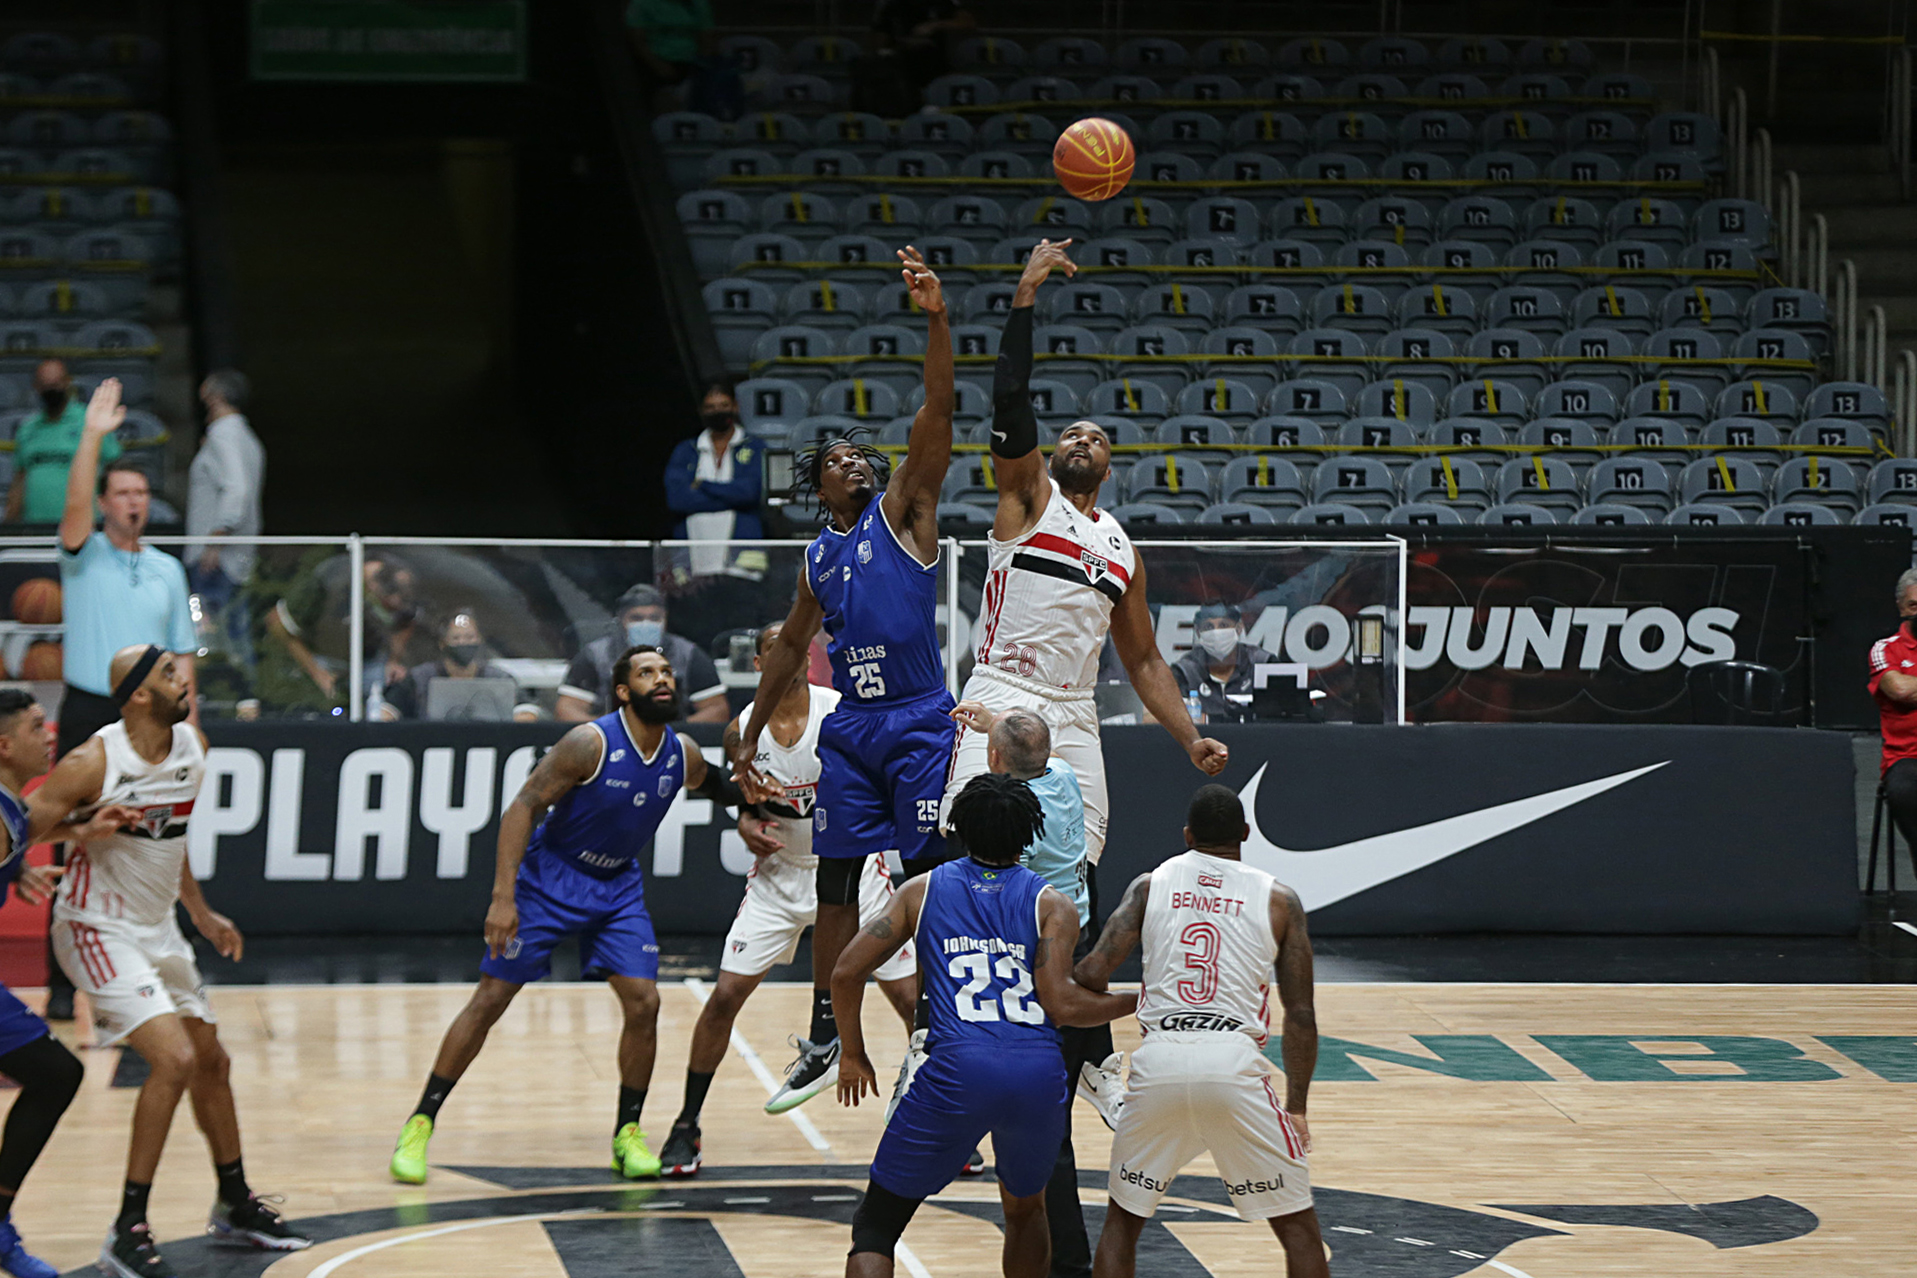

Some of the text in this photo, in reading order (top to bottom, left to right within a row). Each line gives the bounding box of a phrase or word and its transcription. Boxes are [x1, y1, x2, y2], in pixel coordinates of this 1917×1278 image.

[1674, 124, 1690, 141] 13
[1490, 167, 1510, 180] 10
[1576, 168, 1591, 180] 11
[1659, 168, 1676, 180] 12
[1386, 211, 1397, 225] 9
[1468, 211, 1487, 225] 10
[1723, 210, 1740, 228] 13
[1451, 253, 1463, 267] 9
[1534, 252, 1555, 267] 10
[1622, 253, 1640, 268] 11
[1709, 253, 1727, 269] 12
[1257, 298, 1269, 315] 7
[1512, 300, 1535, 315] 10
[1777, 301, 1794, 317] 13
[967, 339, 979, 354] 3
[1233, 342, 1246, 356] 6
[1321, 343, 1334, 358] 7
[1410, 342, 1423, 358] 8
[1498, 343, 1511, 358] 9
[1583, 342, 1604, 358] 10
[1675, 343, 1691, 359] 11
[1761, 343, 1779, 359] 12
[763, 394, 773, 412] 1
[1033, 394, 1046, 411] 4
[1300, 394, 1313, 412] 7
[1564, 395, 1586, 413] 10
[1836, 396, 1855, 414] 13
[1188, 431, 1201, 446] 5
[1278, 431, 1291, 447] 6
[1370, 431, 1383, 447] 7
[1460, 432, 1473, 446] 8
[1551, 432, 1564, 446] 9
[1638, 432, 1659, 447] 10
[1732, 432, 1749, 447] 11
[1821, 432, 1840, 446] 12
[1346, 473, 1358, 488] 7
[1617, 472, 1641, 490] 10
[1897, 474, 1917, 490] 13
[1403, 603, 1740, 672] JUNTOS
[1001, 643, 1037, 677] 28
[849, 662, 886, 699] 25
[916, 799, 939, 821] 25
[1172, 892, 1244, 917] BENNETT
[1178, 922, 1221, 1005] 3
[948, 953, 1045, 1025] 22
[1224, 1172, 1285, 1196] betsul
